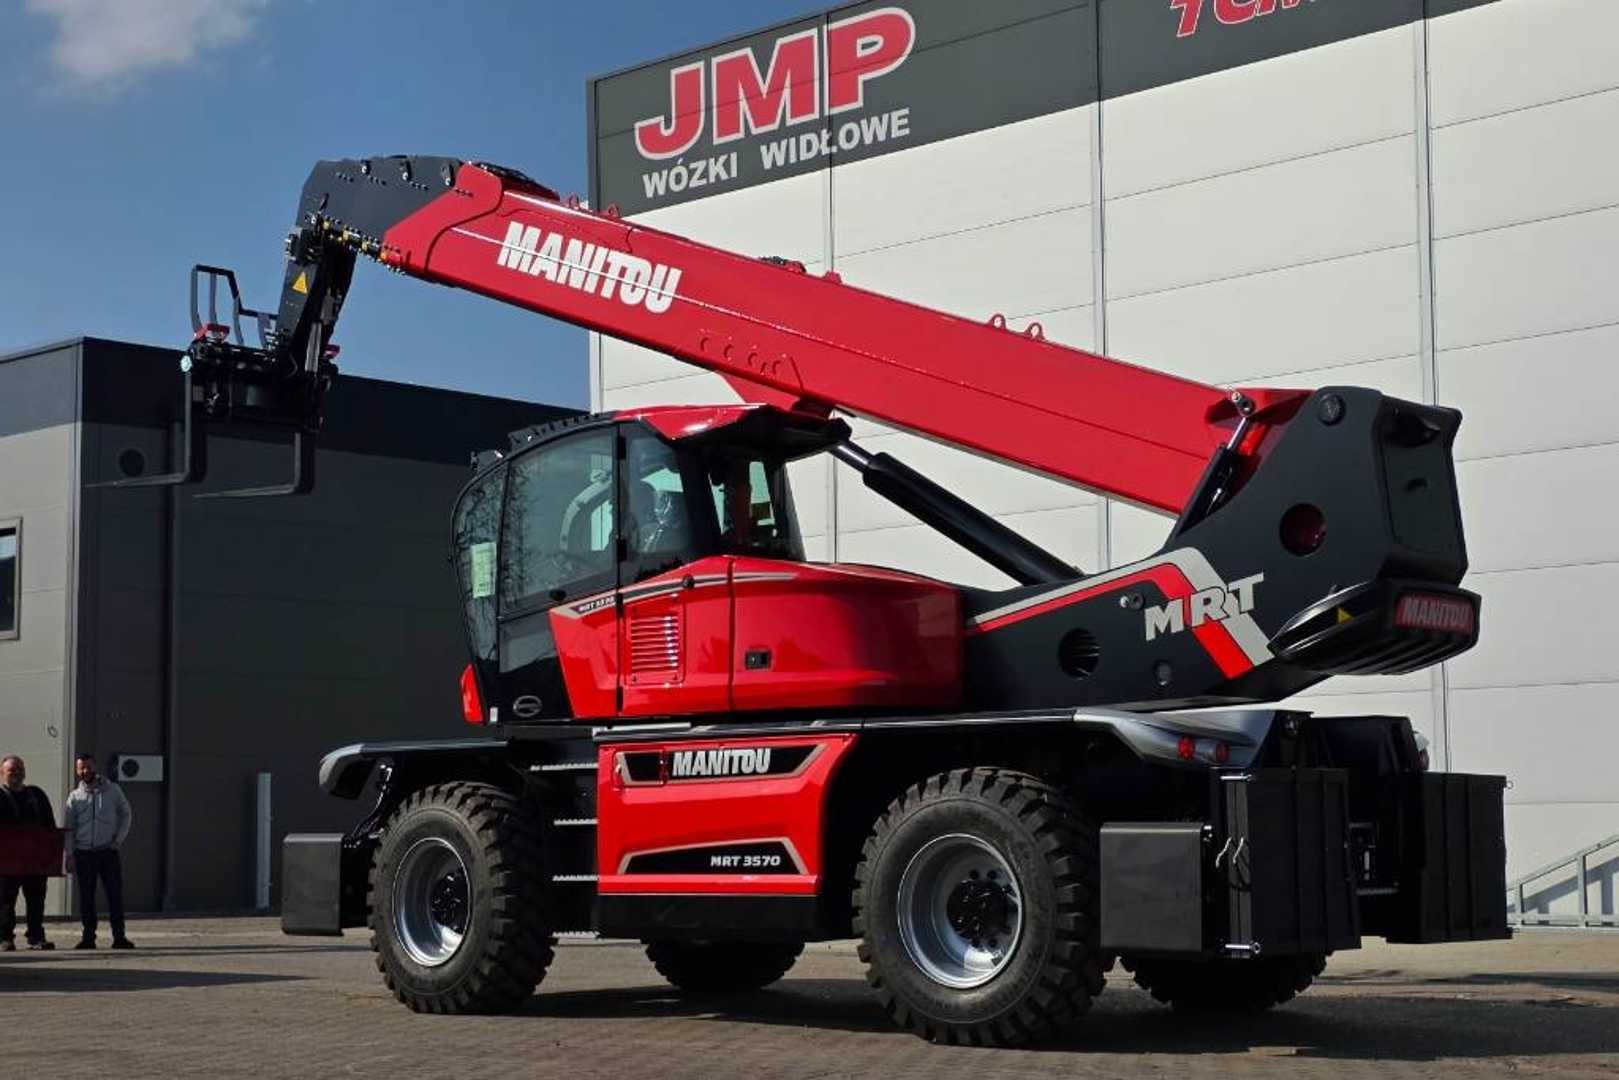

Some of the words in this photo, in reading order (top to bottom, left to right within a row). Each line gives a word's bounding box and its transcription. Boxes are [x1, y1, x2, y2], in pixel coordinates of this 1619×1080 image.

[634, 7, 916, 160] JMP
[642, 151, 738, 199] WÓZKI
[760, 107, 911, 170] WIDŁOWE
[497, 220, 683, 314] MANITOU
[1144, 572, 1264, 641] MRT
[1402, 597, 1473, 627] MANITOU
[672, 747, 772, 777] MANITOU
[710, 855, 742, 867] MRT
[743, 855, 781, 867] 3570
